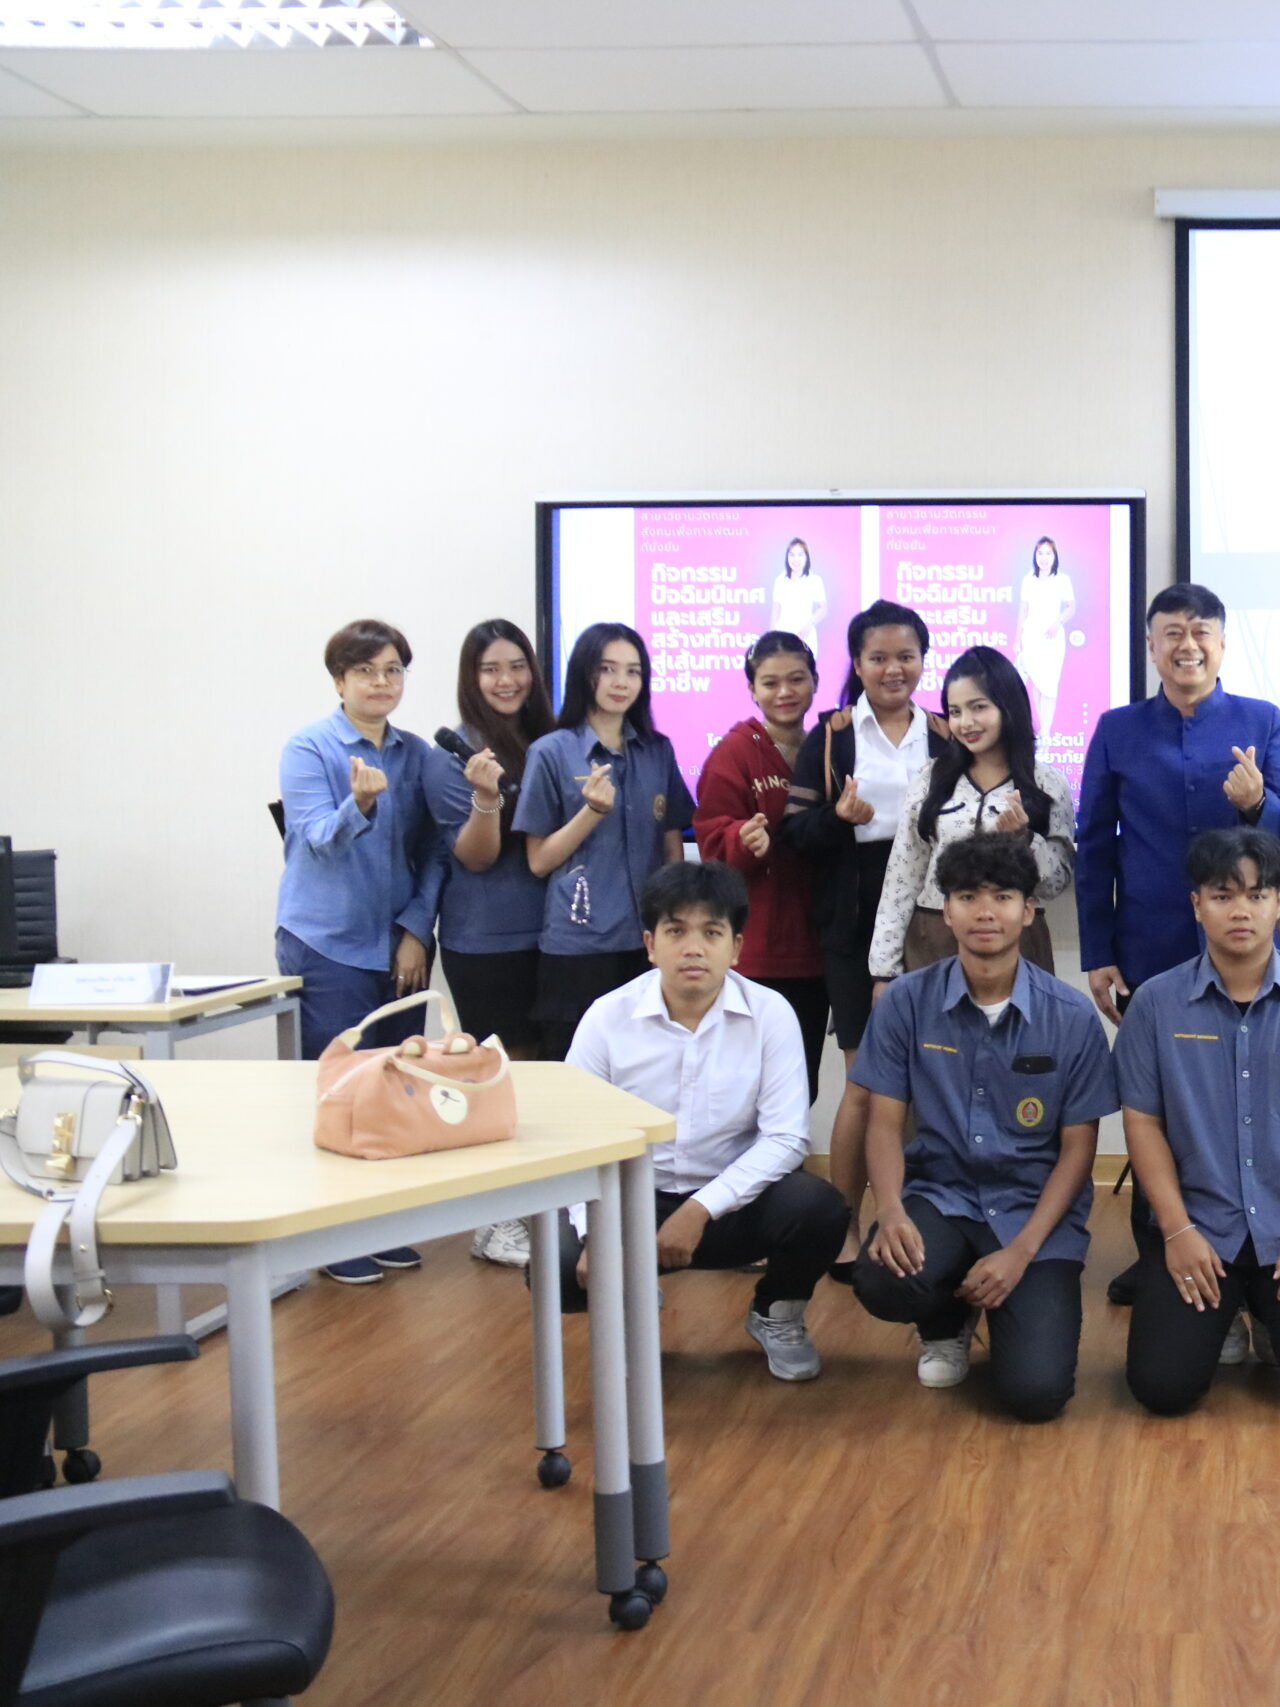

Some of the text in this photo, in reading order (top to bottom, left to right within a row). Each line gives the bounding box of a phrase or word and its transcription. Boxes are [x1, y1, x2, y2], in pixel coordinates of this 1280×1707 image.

[651, 563, 737, 582] กิจกรรม
[896, 561, 984, 581] กิจกรรม
[651, 606, 740, 625] และเสริม
[651, 671, 710, 692] อาชีพ
